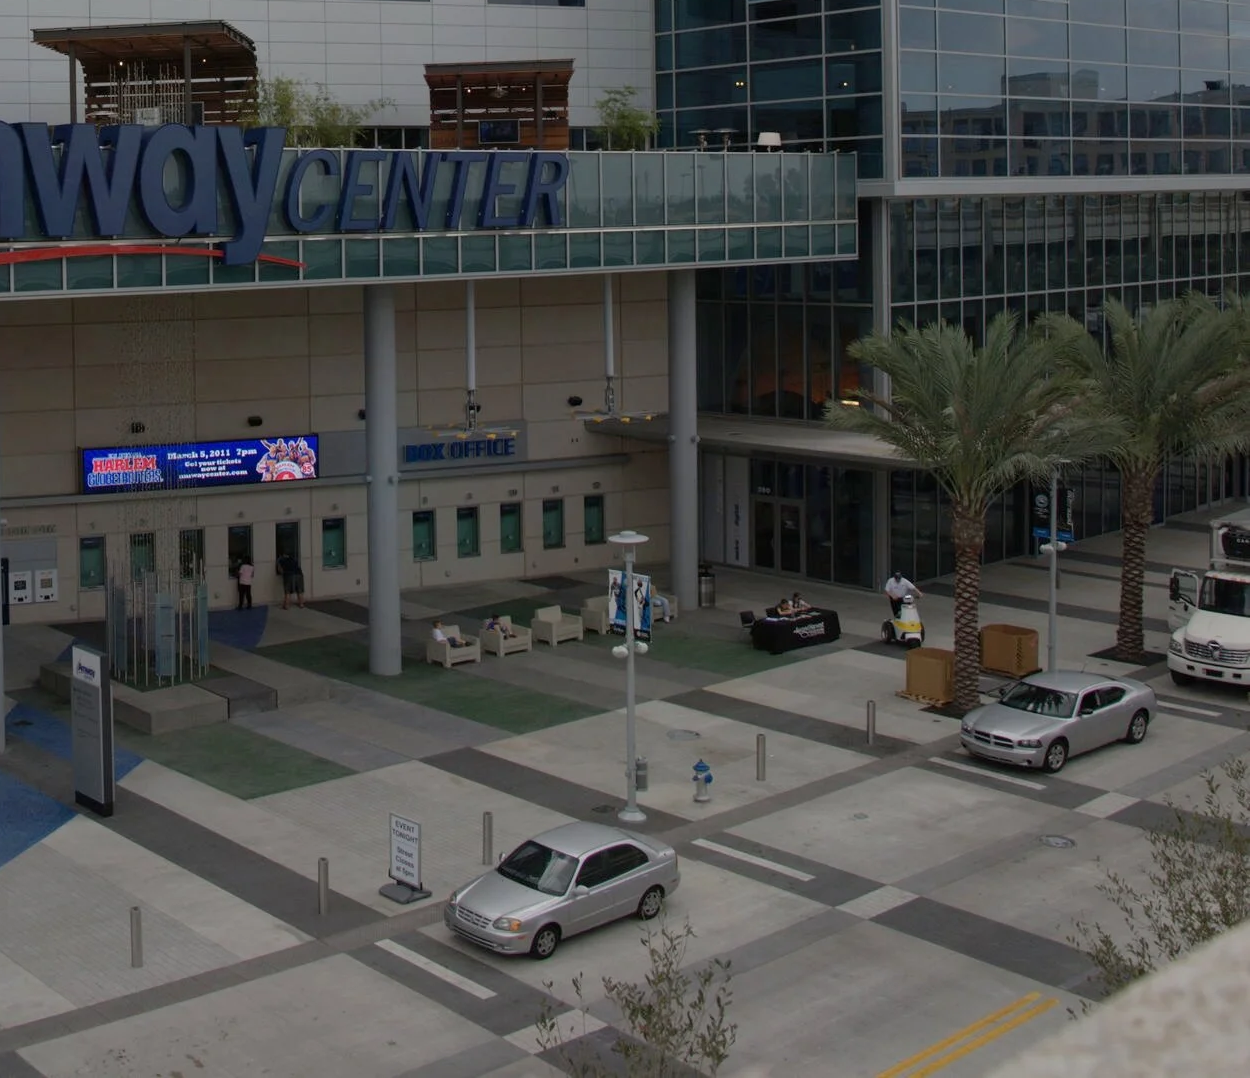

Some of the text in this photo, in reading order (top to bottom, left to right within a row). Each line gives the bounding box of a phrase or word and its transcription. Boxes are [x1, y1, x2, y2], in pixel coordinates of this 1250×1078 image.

[285, 149, 571, 232] CENTER
[167, 451, 198, 460] March
[236, 448, 257, 457] 7pm
[405, 437, 516, 463] BOX OFFICE
[92, 455, 156, 473] HARLEM
[395, 820, 414, 833] EVENT
[392, 828, 418, 843] TONIGHT
